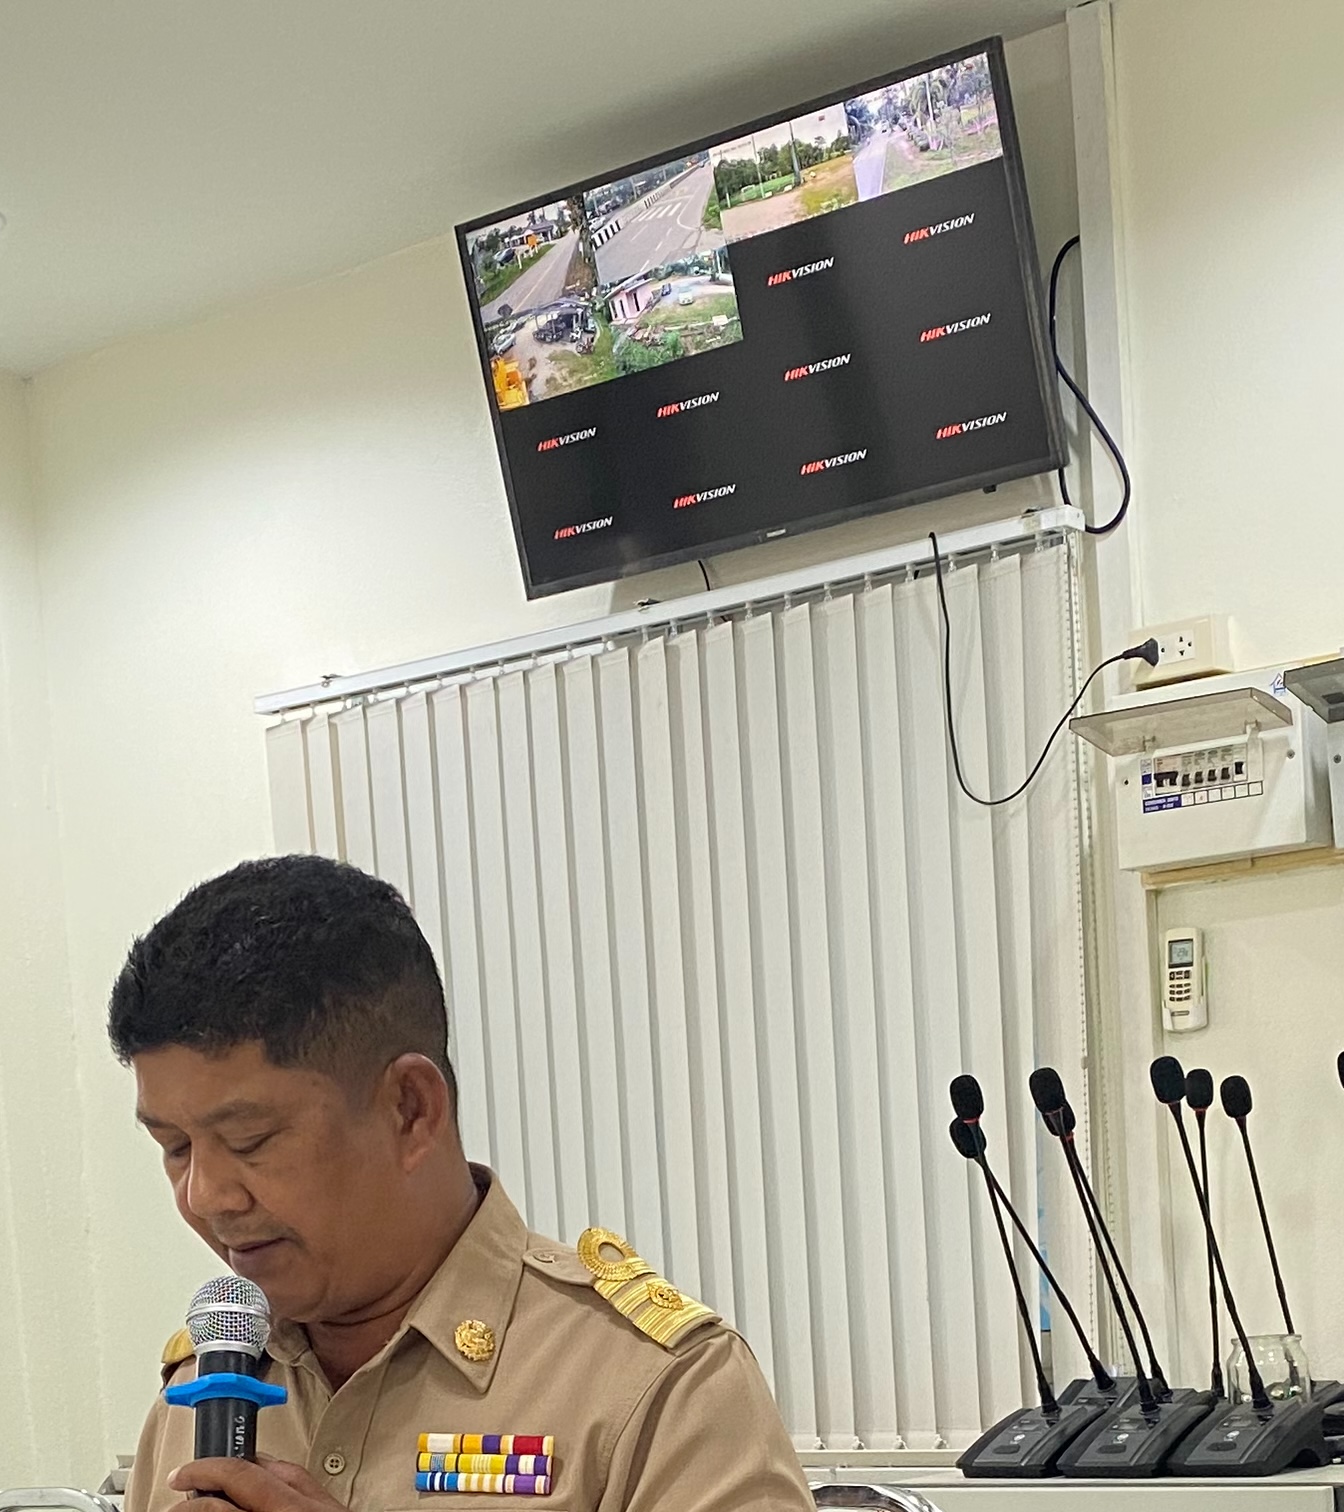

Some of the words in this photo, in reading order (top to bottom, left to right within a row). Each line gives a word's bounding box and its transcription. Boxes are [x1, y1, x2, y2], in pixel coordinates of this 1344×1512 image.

[903, 213, 975, 244] HIKVISION
[767, 256, 835, 287] HIKVISION
[920, 312, 991, 343] HIKVISION
[784, 353, 851, 382] HIKVISION
[657, 391, 720, 418] HIKVISION
[537, 427, 597, 451] HIKVISION
[935, 411, 1007, 440] HIKVISION
[799, 449, 867, 476] HIKVISION
[673, 484, 736, 509] HIKVISION
[553, 516, 613, 540] HIKVISION
